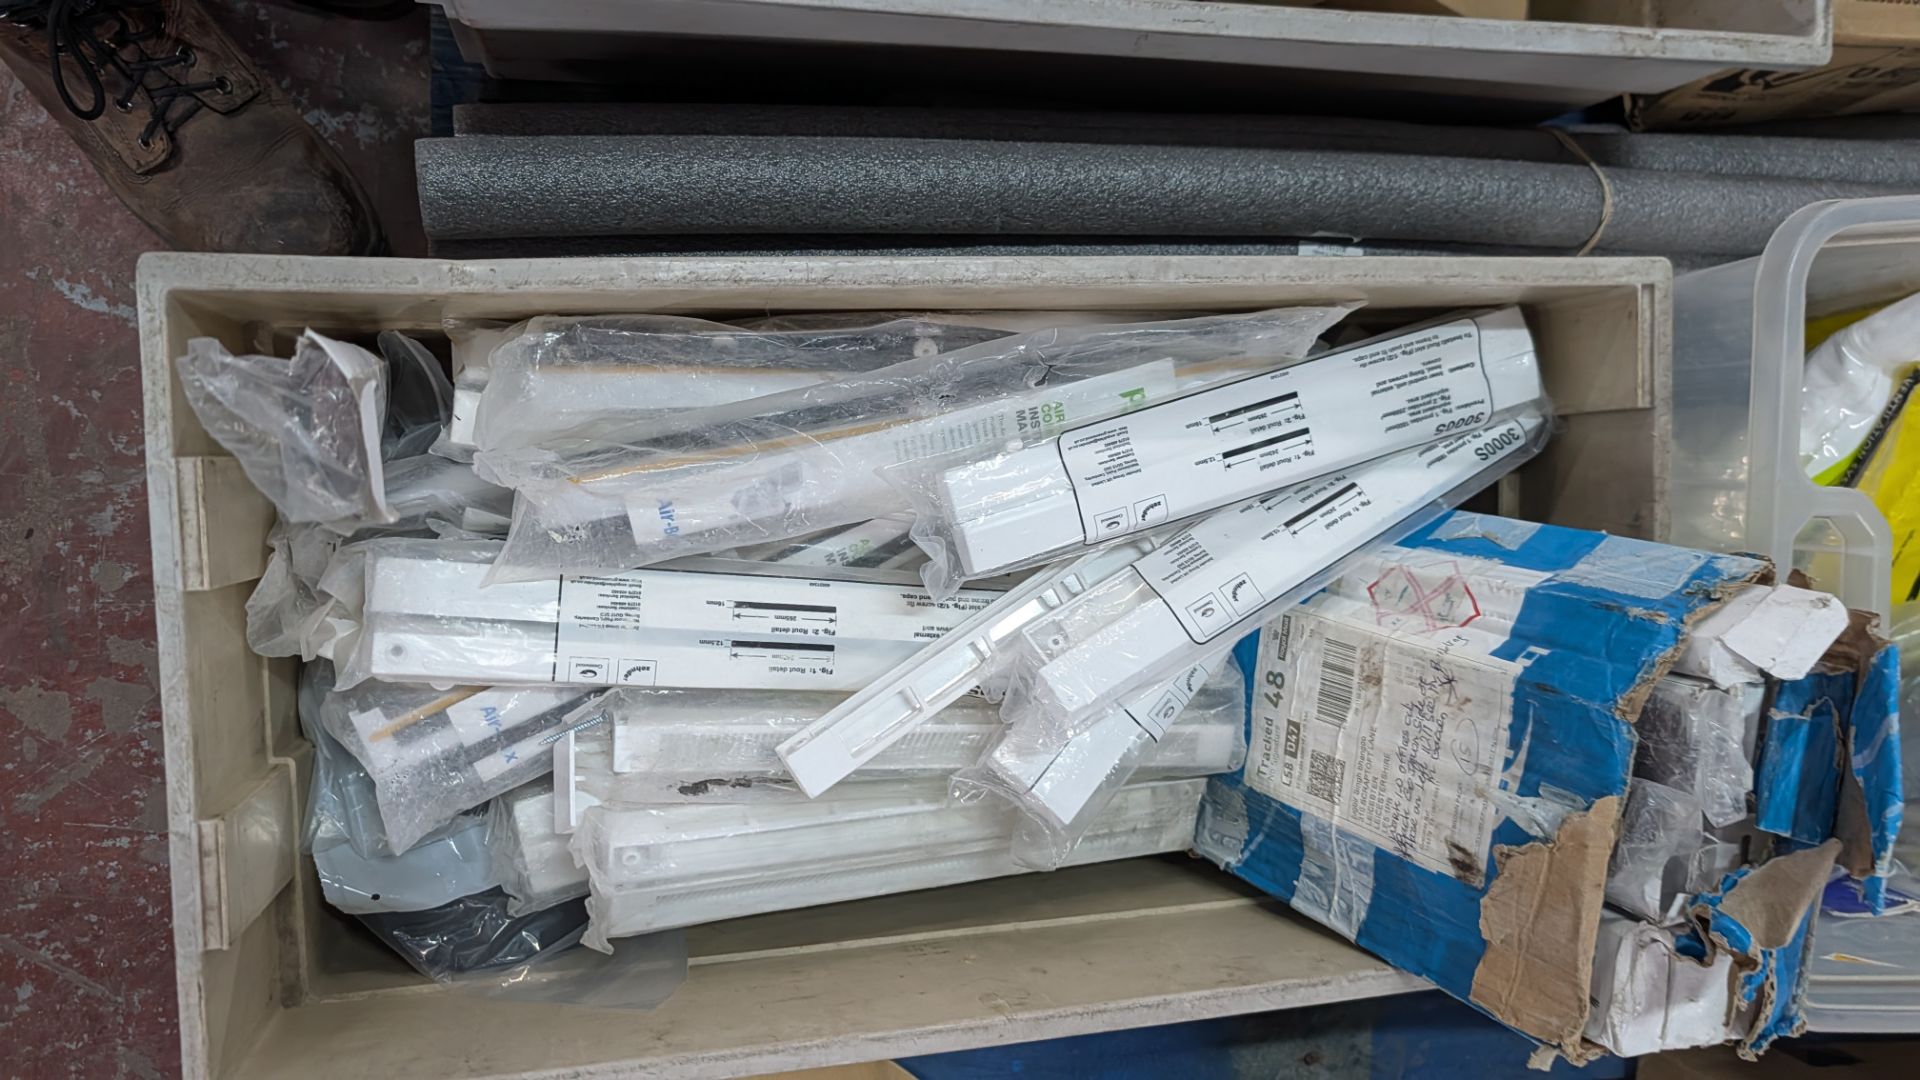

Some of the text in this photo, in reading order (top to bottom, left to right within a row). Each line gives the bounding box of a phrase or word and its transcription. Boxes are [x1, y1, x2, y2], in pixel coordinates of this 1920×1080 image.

[1050, 400, 1067, 422] AIR
[1406, 397, 1432, 412] provides
[1292, 412, 1305, 421] Fig.
[1409, 411, 1433, 425] provides
[1431, 409, 1486, 437] 3000S
[1249, 424, 1266, 434] detail
[1266, 420, 1281, 429] Rout
[1472, 425, 1521, 463] 3000S
[1301, 448, 1314, 457] Fig.
[1259, 461, 1276, 471] detail
[1276, 456, 1291, 465] Rout
[1334, 473, 1346, 483] Fig.
[1299, 492, 1314, 504] detail
[1358, 498, 1370, 509] Fig.
[1140, 501, 1161, 522] zehnder
[1338, 510, 1352, 521] Rout
[1323, 517, 1339, 530] detail
[1232, 579, 1246, 601] zehnder
[1279, 616, 1289, 658] Royal Mail
[622, 665, 649, 681] zehnder
[1263, 670, 1286, 708] 48
[1286, 725, 1298, 752] D47
[1367, 726, 1376, 749] LANE
[1255, 716, 1274, 778] Tracked
[1375, 752, 1390, 830] LEICESTERSHIRE
[1365, 776, 1378, 826] LEICESTER
